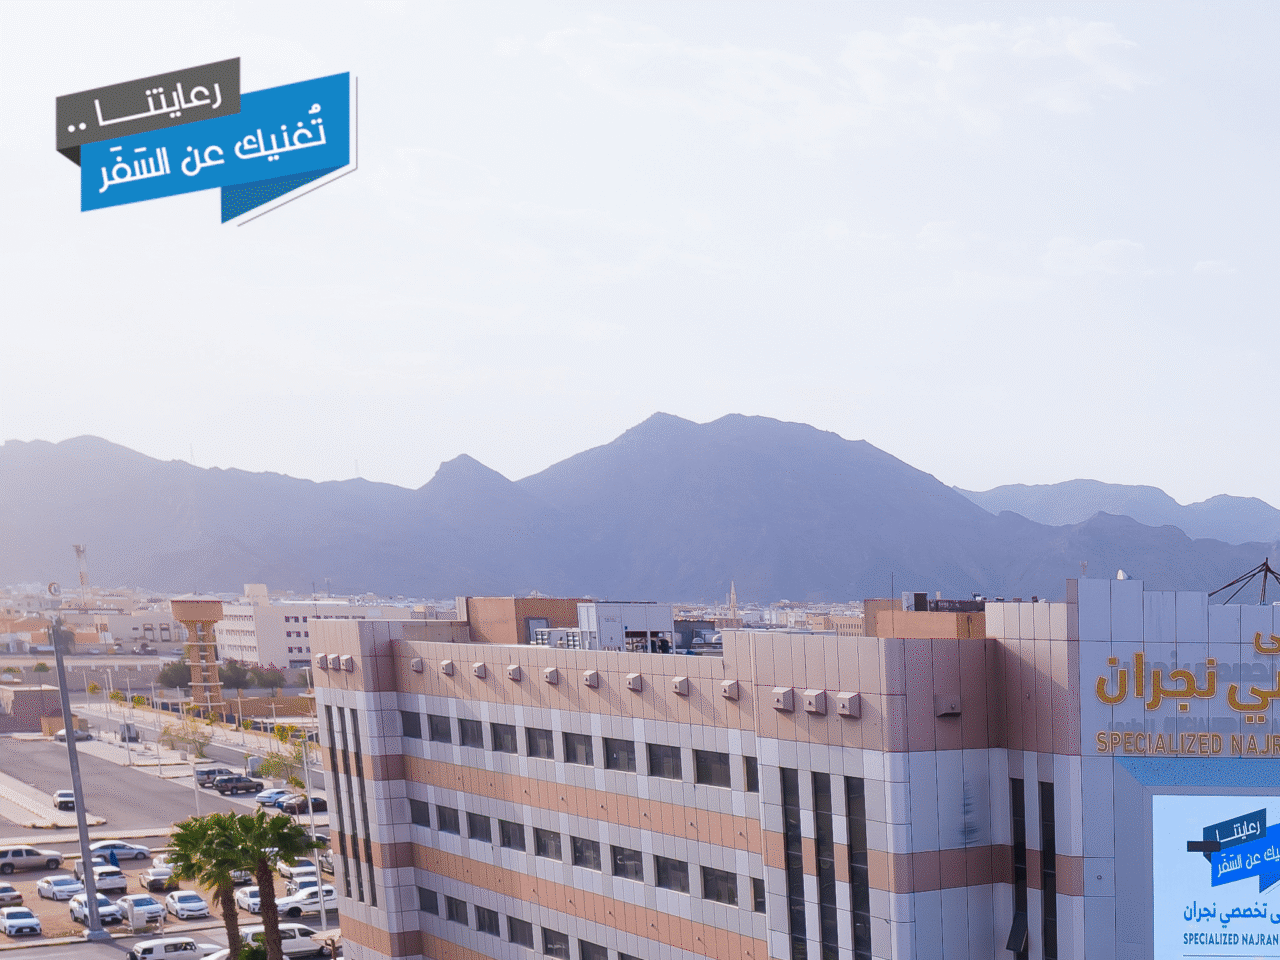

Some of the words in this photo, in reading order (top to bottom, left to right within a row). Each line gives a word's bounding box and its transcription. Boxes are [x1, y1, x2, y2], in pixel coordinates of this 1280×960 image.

[1095, 652, 1218, 712] نجران
[1095, 731, 1223, 755] SPECIALIZED
[1245, 853, 1262, 870] عن
[1183, 901, 1217, 923] نجران
[1219, 902, 1268, 929] تخصصي
[1183, 933, 1240, 945] SPECIALIZED
[1241, 933, 1280, 946] NAJRAN
